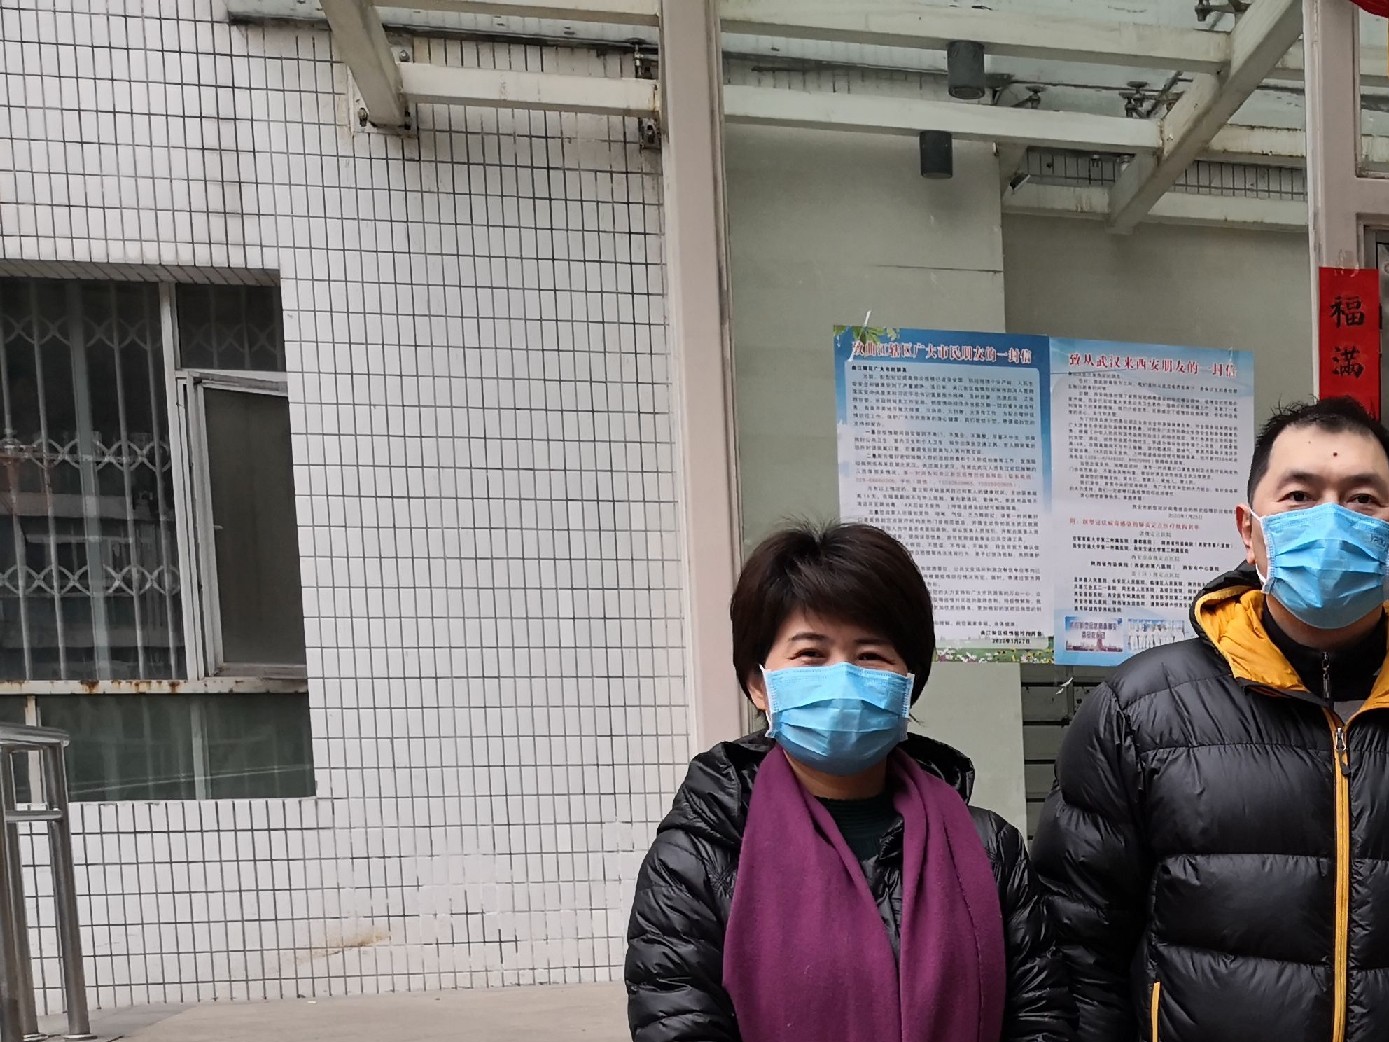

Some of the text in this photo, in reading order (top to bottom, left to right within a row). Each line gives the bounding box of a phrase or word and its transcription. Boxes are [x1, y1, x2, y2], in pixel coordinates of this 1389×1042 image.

[1068, 352, 1238, 378] 致从武汉来西安朋友的一封信
